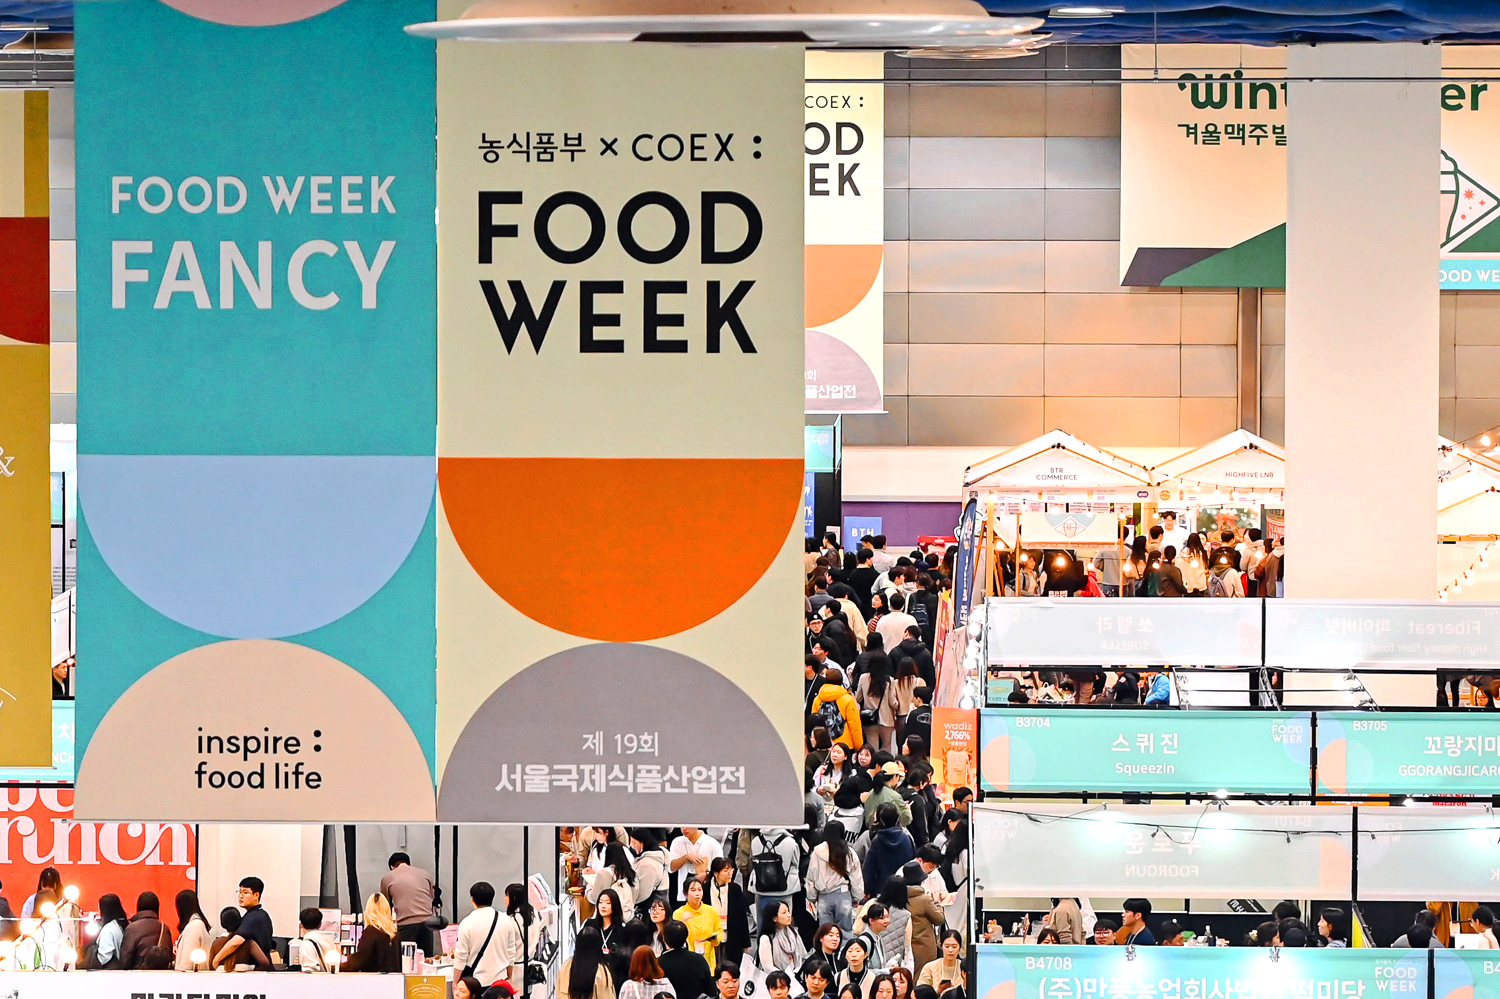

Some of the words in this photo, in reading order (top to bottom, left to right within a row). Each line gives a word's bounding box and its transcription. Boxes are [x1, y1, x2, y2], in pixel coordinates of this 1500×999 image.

[477, 130, 587, 163] 농식품부
[631, 132, 736, 162] COEX
[804, 121, 865, 156] OD
[809, 162, 862, 197] EK
[111, 175, 248, 215] FOOD
[262, 174, 397, 214] WEEK
[477, 189, 764, 266] FOOD
[110, 239, 397, 311] FANCY
[478, 279, 758, 356] WEEK
[1035, 473, 1078, 482] COMMERCE
[1050, 466, 1064, 474] BTR
[1225, 471, 1257, 479] HIGHFIVE
[1257, 471, 1275, 479] LNB
[943, 722, 972, 730] wadiz
[1015, 717, 1051, 728] B3704
[1271, 724, 1304, 734] FOOD
[1352, 720, 1388, 731] B3705
[196, 726, 303, 761] inspire
[581, 731, 605, 757] 제
[613, 731, 660, 757] 19회
[1272, 734, 1303, 744] WEEK
[194, 761, 266, 790] food
[274, 762, 323, 790] life
[1115, 760, 1175, 776] Squeezin
[494, 763, 747, 796] 서울국제식품산업전
[1024, 956, 1074, 971] B4708
[1374, 966, 1418, 979] FOOD
[1375, 980, 1418, 992] WEEK
